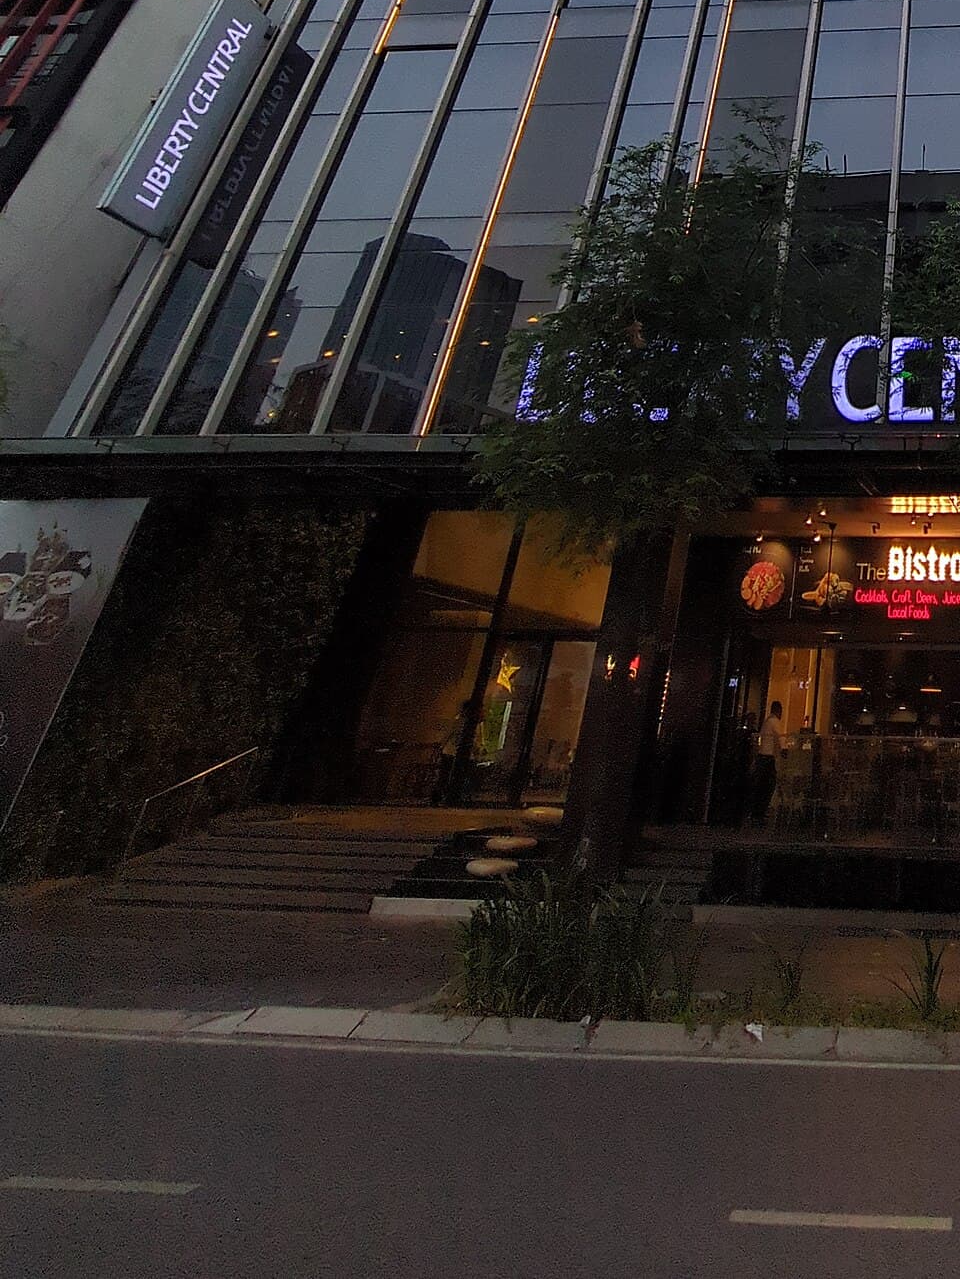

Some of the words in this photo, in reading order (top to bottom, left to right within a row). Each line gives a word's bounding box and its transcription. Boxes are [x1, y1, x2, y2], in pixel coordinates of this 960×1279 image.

[134, 108, 200, 211] LIBERTY
[187, 17, 253, 116] CENTRAL
[856, 563, 886, 581] The
[887, 604, 908, 619] Local
[908, 605, 930, 619] Foods
